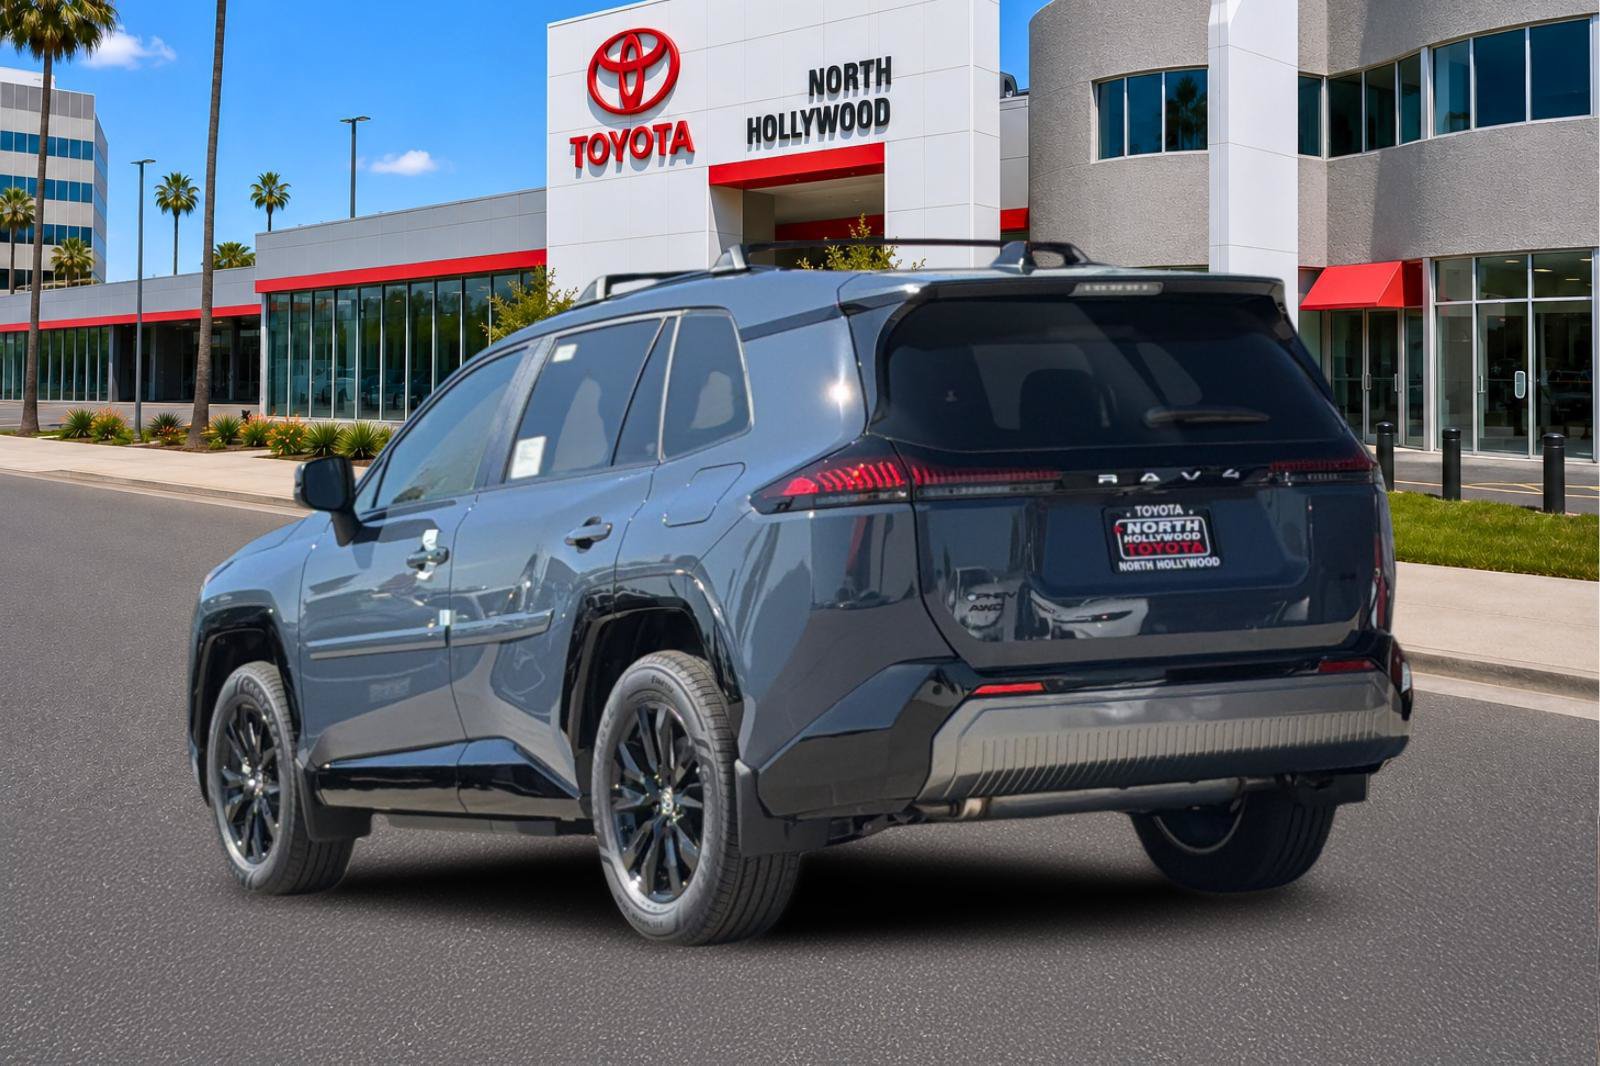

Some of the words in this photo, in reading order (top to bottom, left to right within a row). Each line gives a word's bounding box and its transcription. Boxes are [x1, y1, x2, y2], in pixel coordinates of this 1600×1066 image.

[809, 56, 891, 96] NORTH
[747, 97, 890, 145] HOLLYWOOD
[569, 120, 695, 169] TOYOTA
[1098, 468, 1240, 484] RAV4
[1135, 504, 1184, 517] TOYOTA
[1127, 520, 1199, 534] NORTH
[1124, 532, 1201, 543] HOLLYWOOD
[1126, 541, 1204, 556] TOYOTA
[1119, 561, 1154, 572] NORTH
[1156, 557, 1220, 570] HOLLYWOOD
